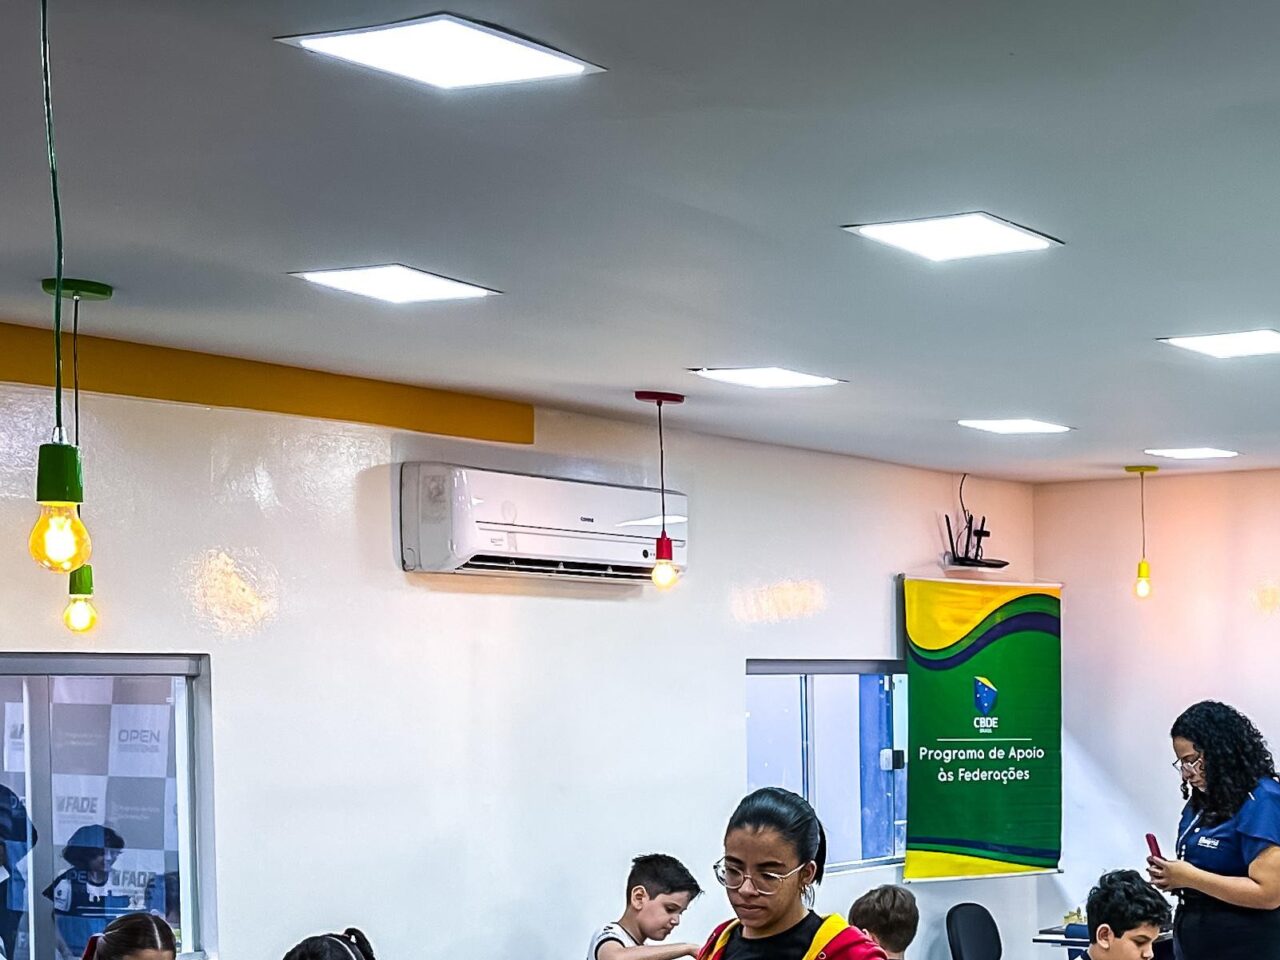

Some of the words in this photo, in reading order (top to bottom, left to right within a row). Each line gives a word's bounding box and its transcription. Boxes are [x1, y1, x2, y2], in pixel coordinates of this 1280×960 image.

[973, 717, 999, 728] CBDE
[118, 729, 160, 743] OPEN
[919, 747, 985, 763] Programa
[988, 747, 1005, 760] de
[1008, 746, 1045, 761] Apoio
[937, 767, 954, 782] às
[958, 767, 1030, 784] Federações
[65, 797, 99, 813] FADE
